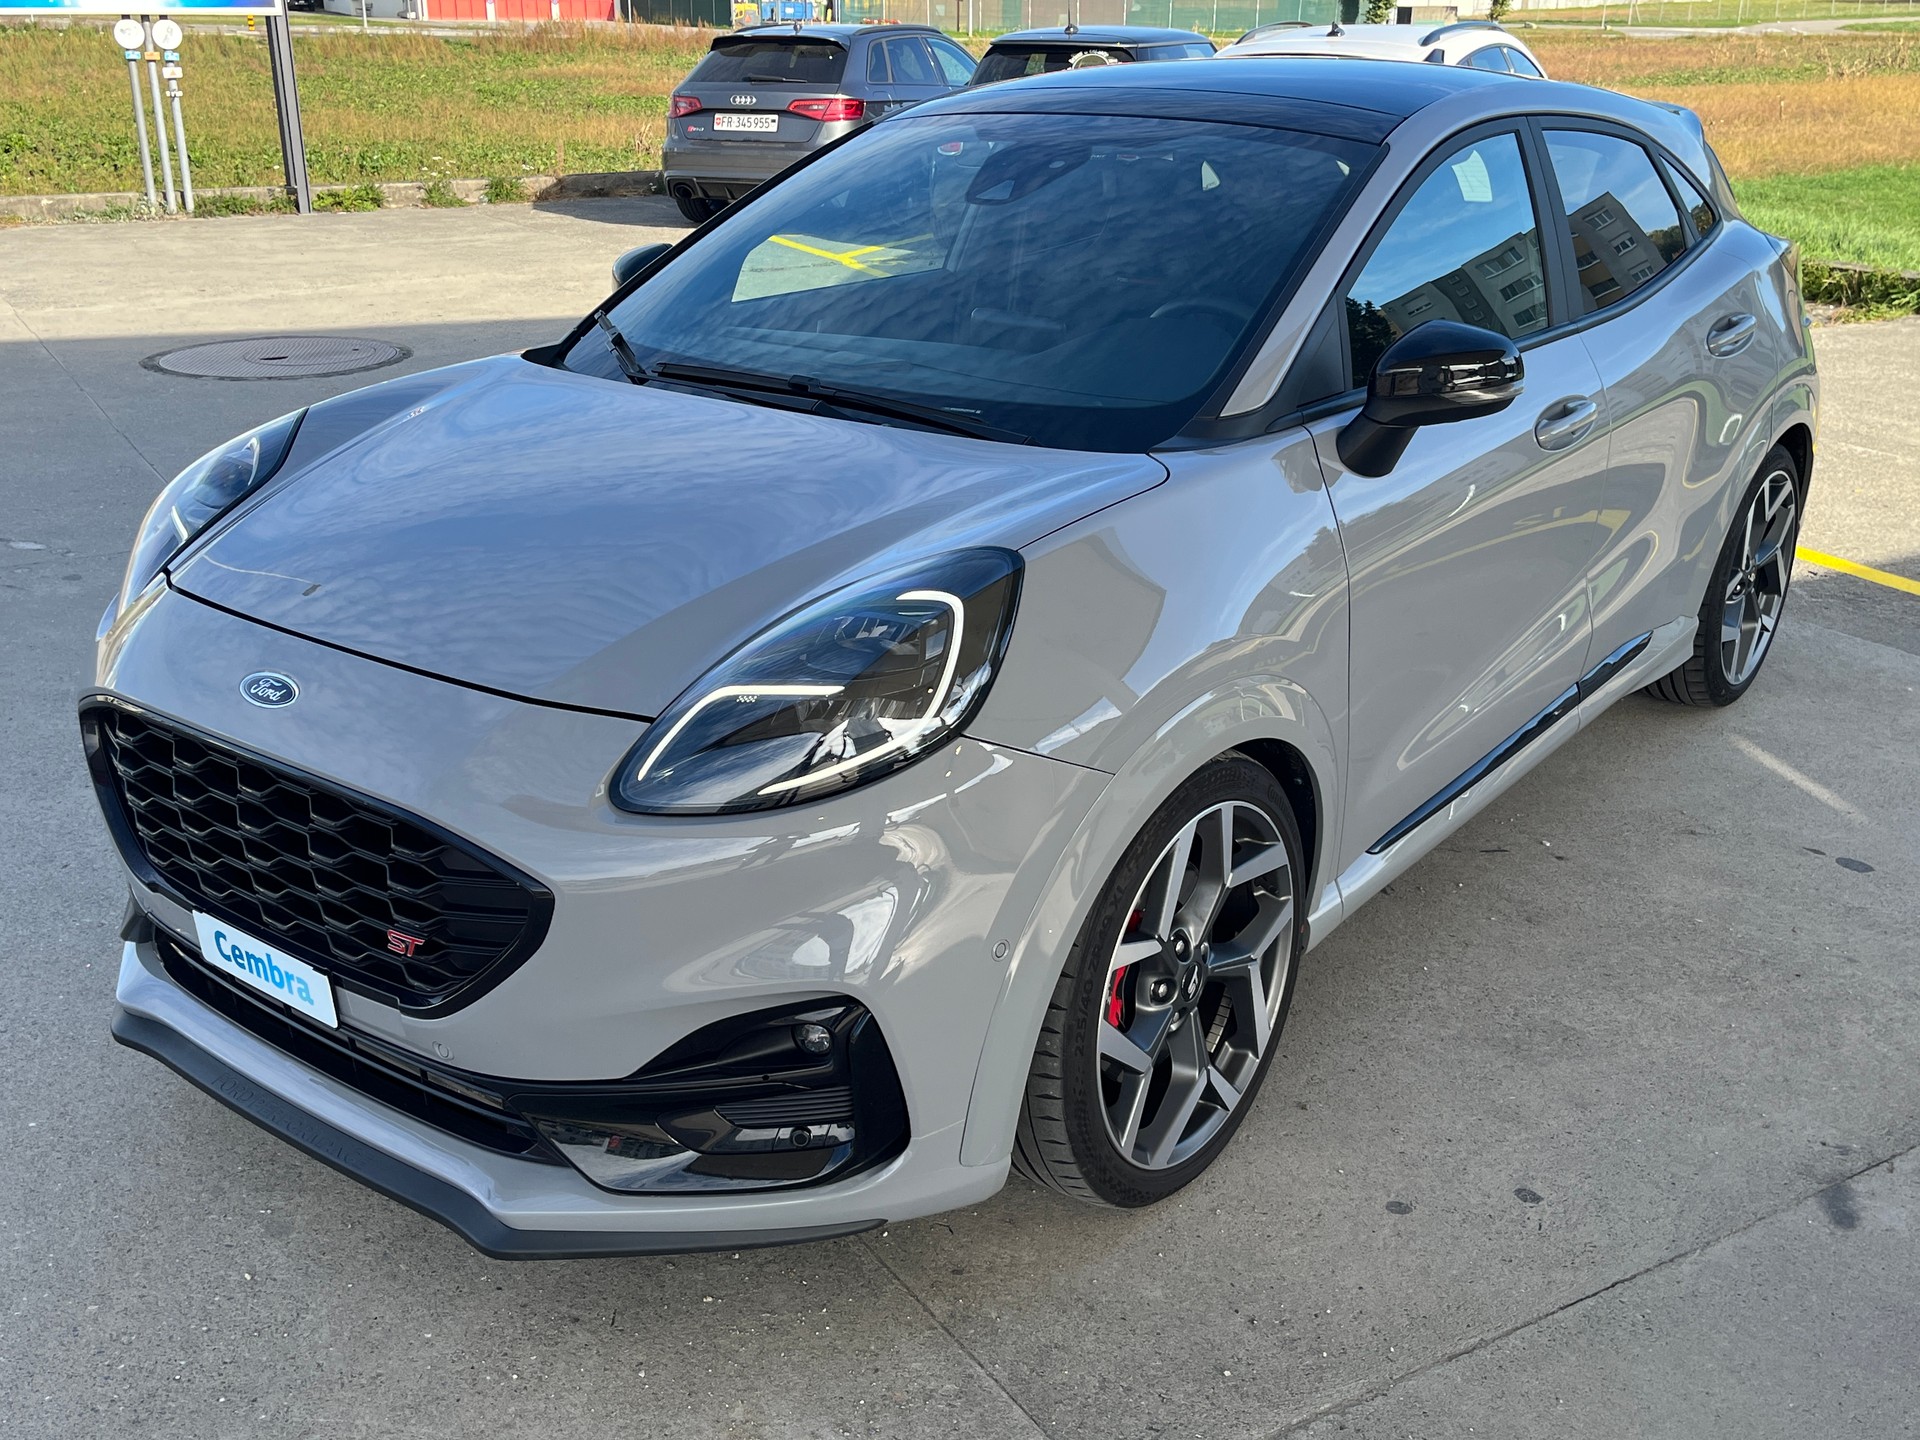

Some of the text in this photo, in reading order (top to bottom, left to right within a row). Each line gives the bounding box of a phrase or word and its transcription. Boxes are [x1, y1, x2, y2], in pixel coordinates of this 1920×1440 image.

[250, 678, 287, 701] Ford
[387, 929, 426, 957] ST
[213, 929, 315, 1006] Cembra
[211, 1072, 255, 1104] FORD
